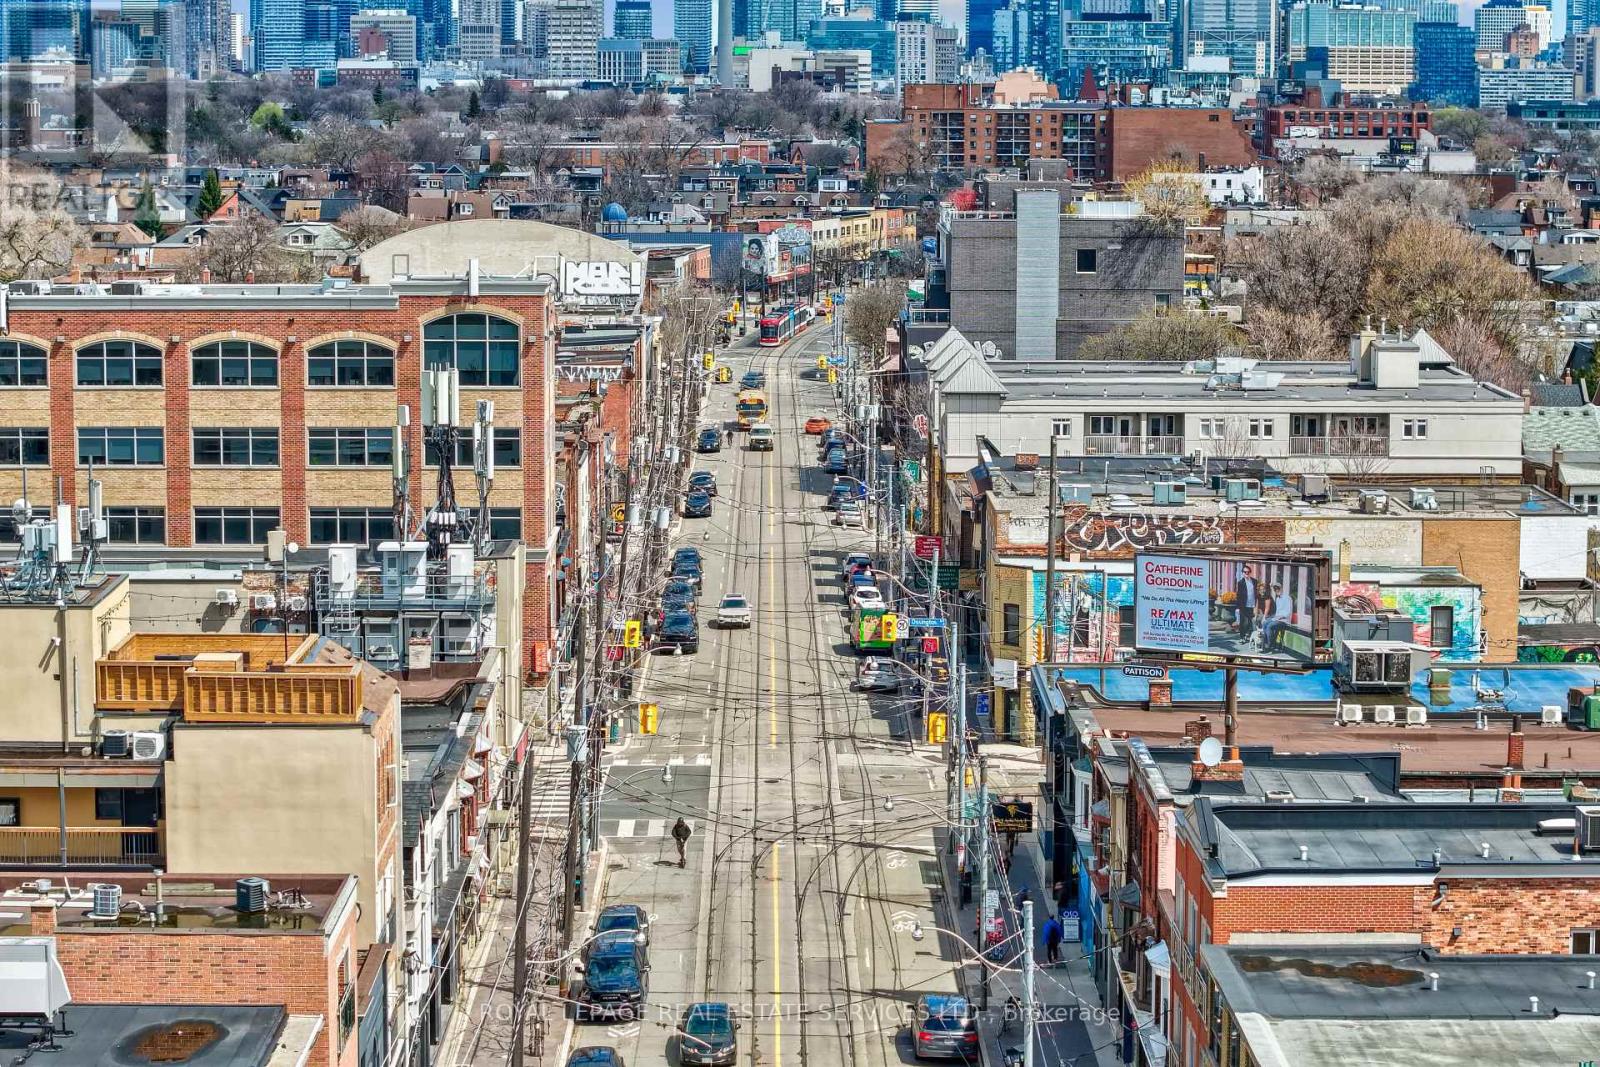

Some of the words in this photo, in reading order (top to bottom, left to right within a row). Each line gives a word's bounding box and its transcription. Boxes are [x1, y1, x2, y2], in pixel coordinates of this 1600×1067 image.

[1145, 561, 1203, 576] CATHERINE
[1145, 574, 1192, 587] GORDON
[1151, 608, 1194, 620] RE/MAX
[1151, 619, 1195, 629] ULTIMATE
[1125, 667, 1162, 677] PATTISON
